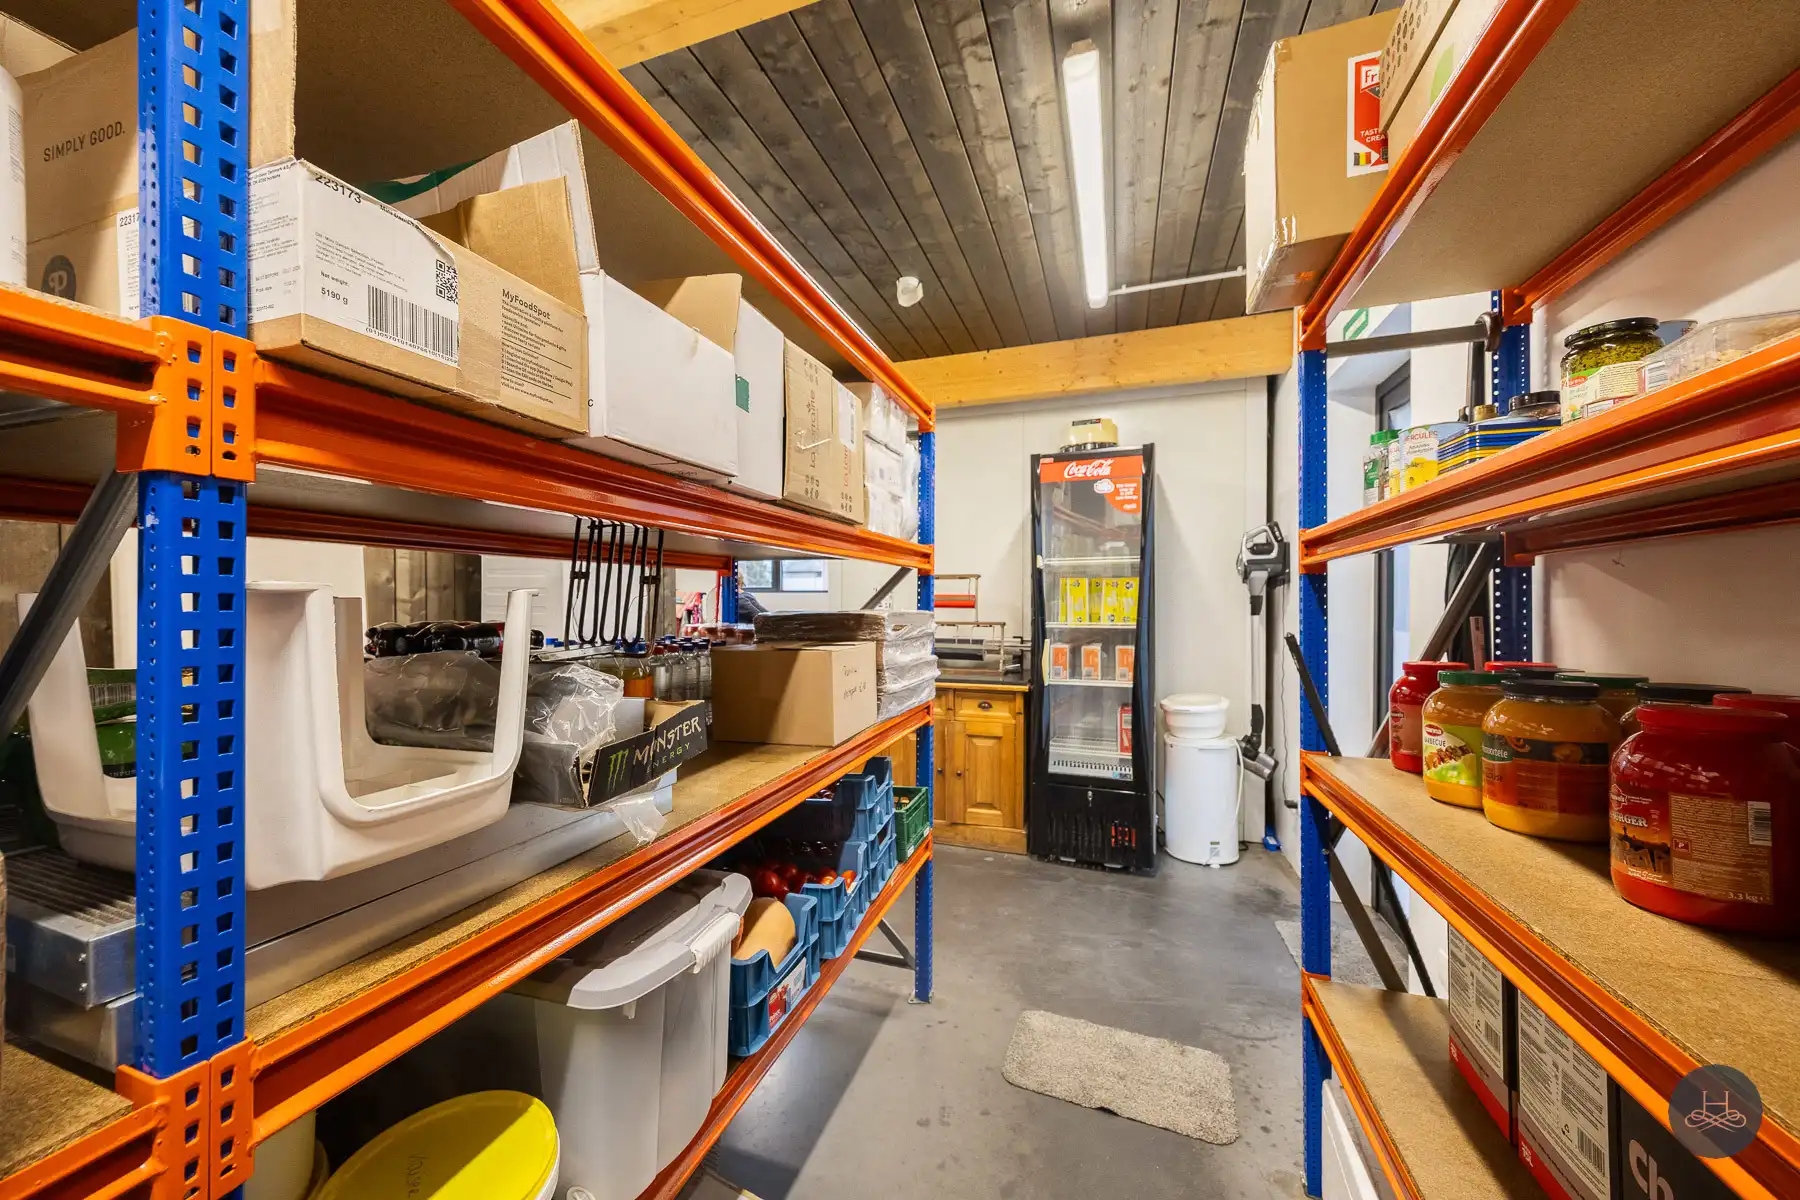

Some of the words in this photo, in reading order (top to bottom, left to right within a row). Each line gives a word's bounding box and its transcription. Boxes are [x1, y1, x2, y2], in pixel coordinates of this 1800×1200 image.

[44, 135, 85, 162] SIMPLY
[90, 121, 126, 146] GOOD.
[315, 172, 362, 204] 223173
[321, 287, 340, 300] 5190
[343, 297, 348, 305] g
[502, 288, 550, 320] MyFoodSpot
[1064, 459, 1114, 478] Coca-Cola
[1728, 891, 1743, 900] 3.3
[1746, 892, 1758, 904] kg
